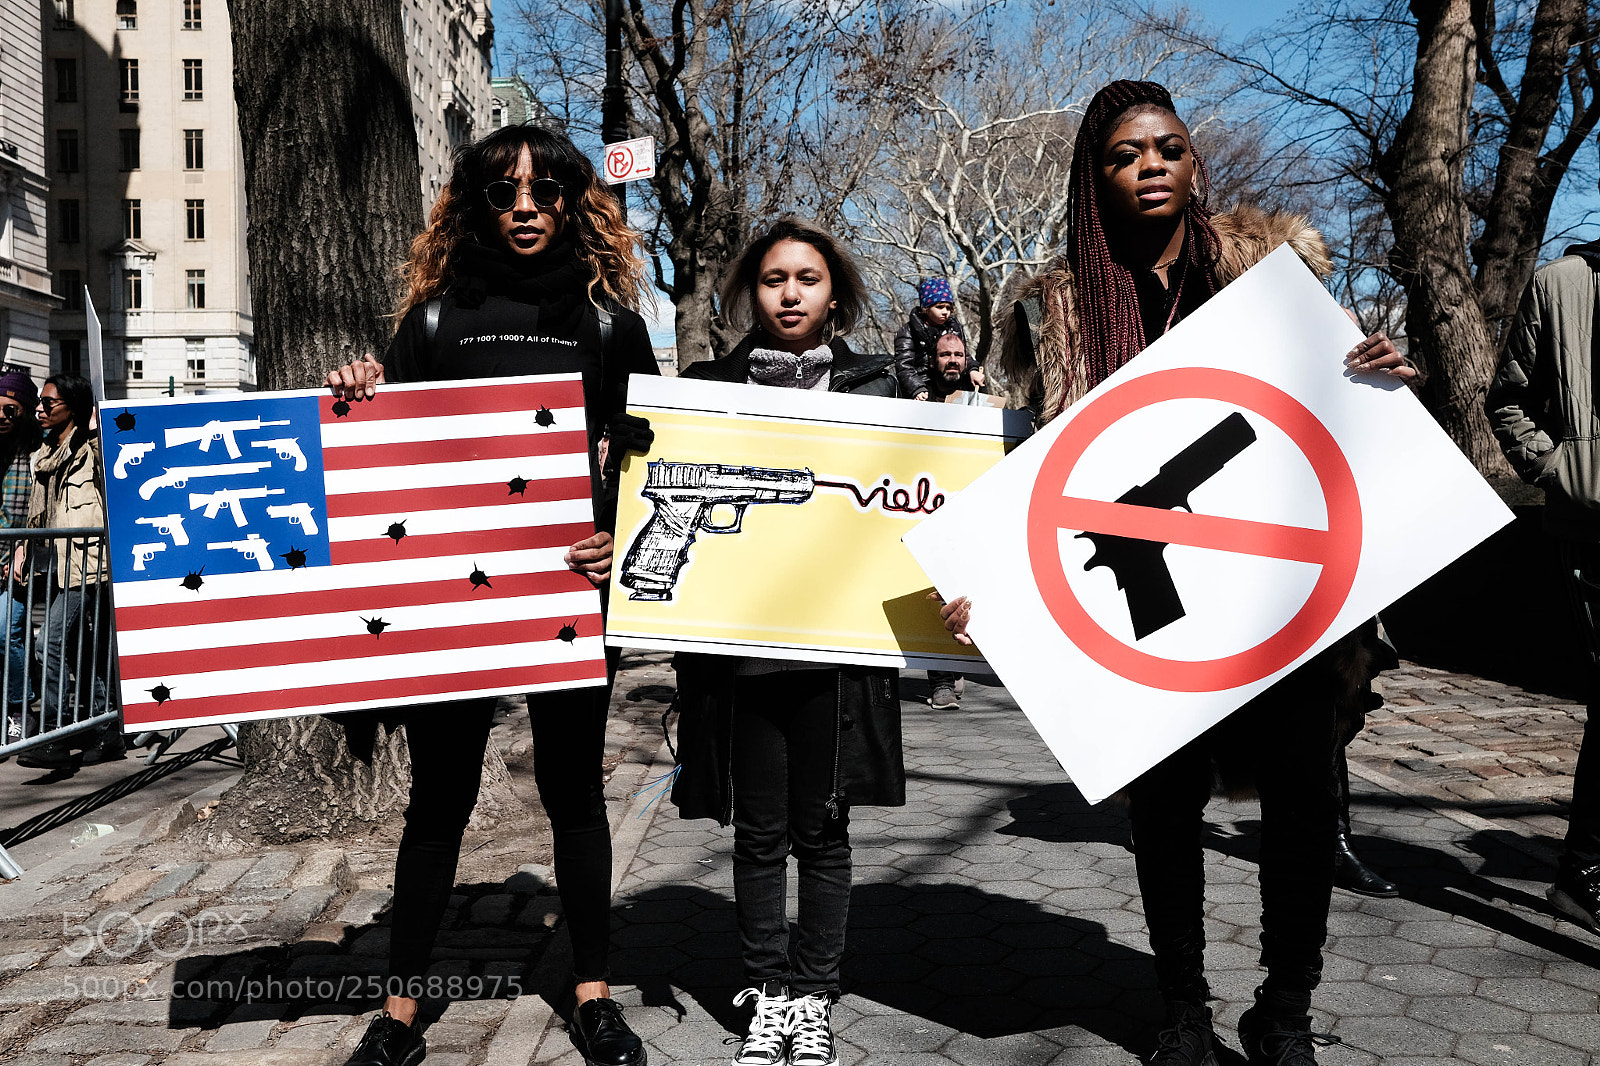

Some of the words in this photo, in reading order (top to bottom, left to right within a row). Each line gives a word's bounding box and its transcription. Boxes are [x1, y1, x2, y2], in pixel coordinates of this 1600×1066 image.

[459, 337, 474, 346] 17?
[499, 334, 524, 342] 1000?
[551, 337, 578, 347] them?
